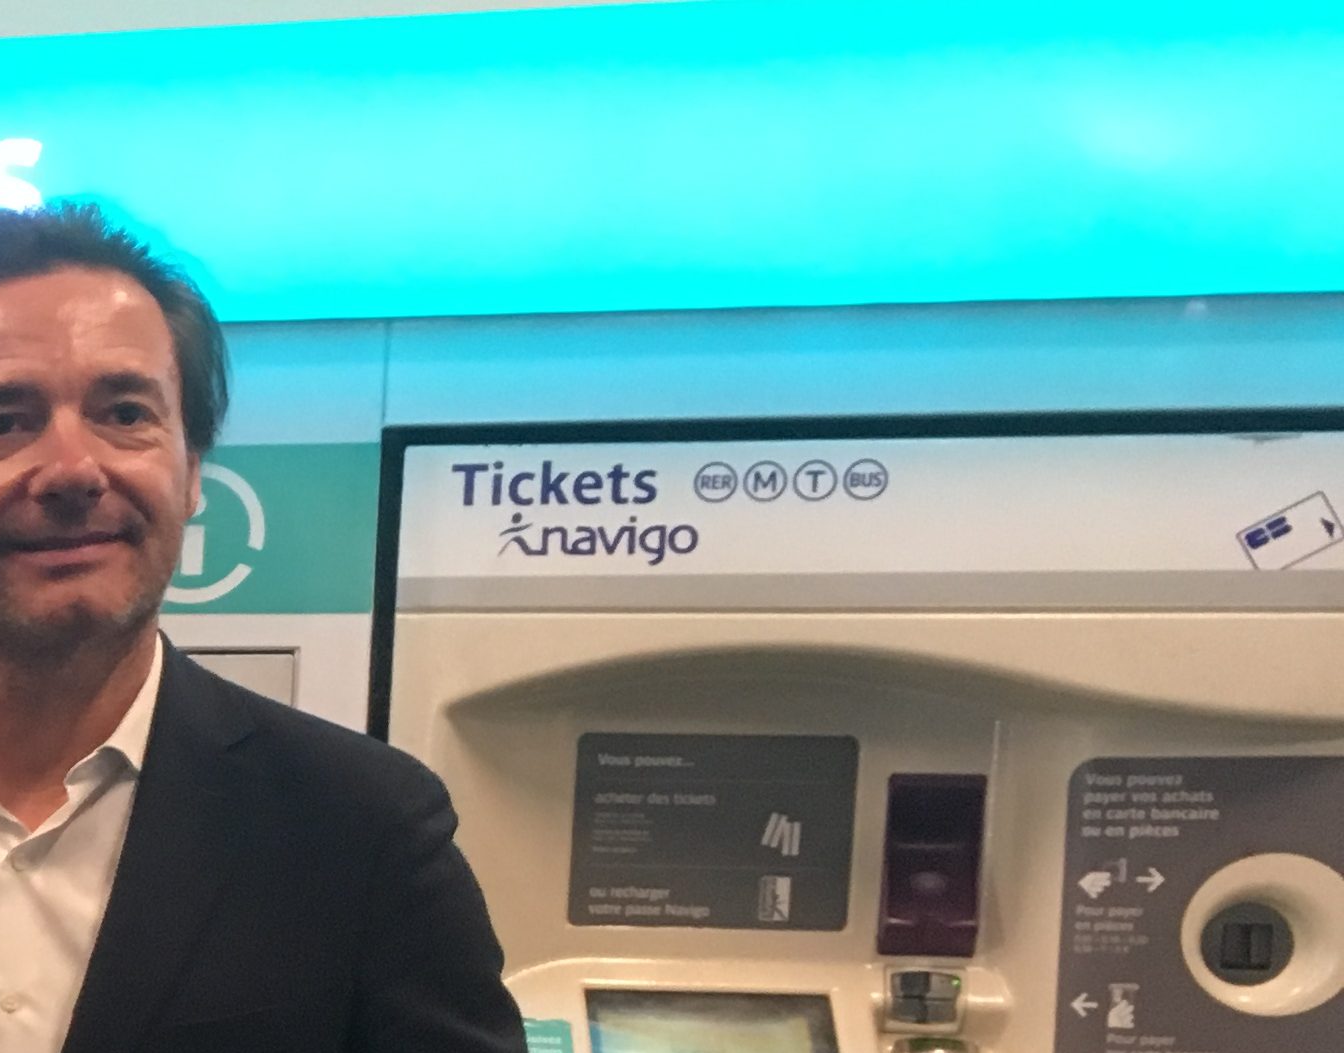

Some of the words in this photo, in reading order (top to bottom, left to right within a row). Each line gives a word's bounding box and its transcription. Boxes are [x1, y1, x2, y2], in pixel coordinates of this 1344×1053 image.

[451, 460, 658, 506] Tickets
[700, 473, 733, 490] RER
[849, 472, 883, 489] BUS
[530, 515, 699, 565] navigo
[1085, 773, 1122, 786] Vous
[1127, 774, 1183, 788] pouvez
[1163, 790, 1214, 803] achats
[1082, 808, 1102, 820] en
[1105, 807, 1146, 820] carte
[1150, 806, 1220, 820] bancaire
